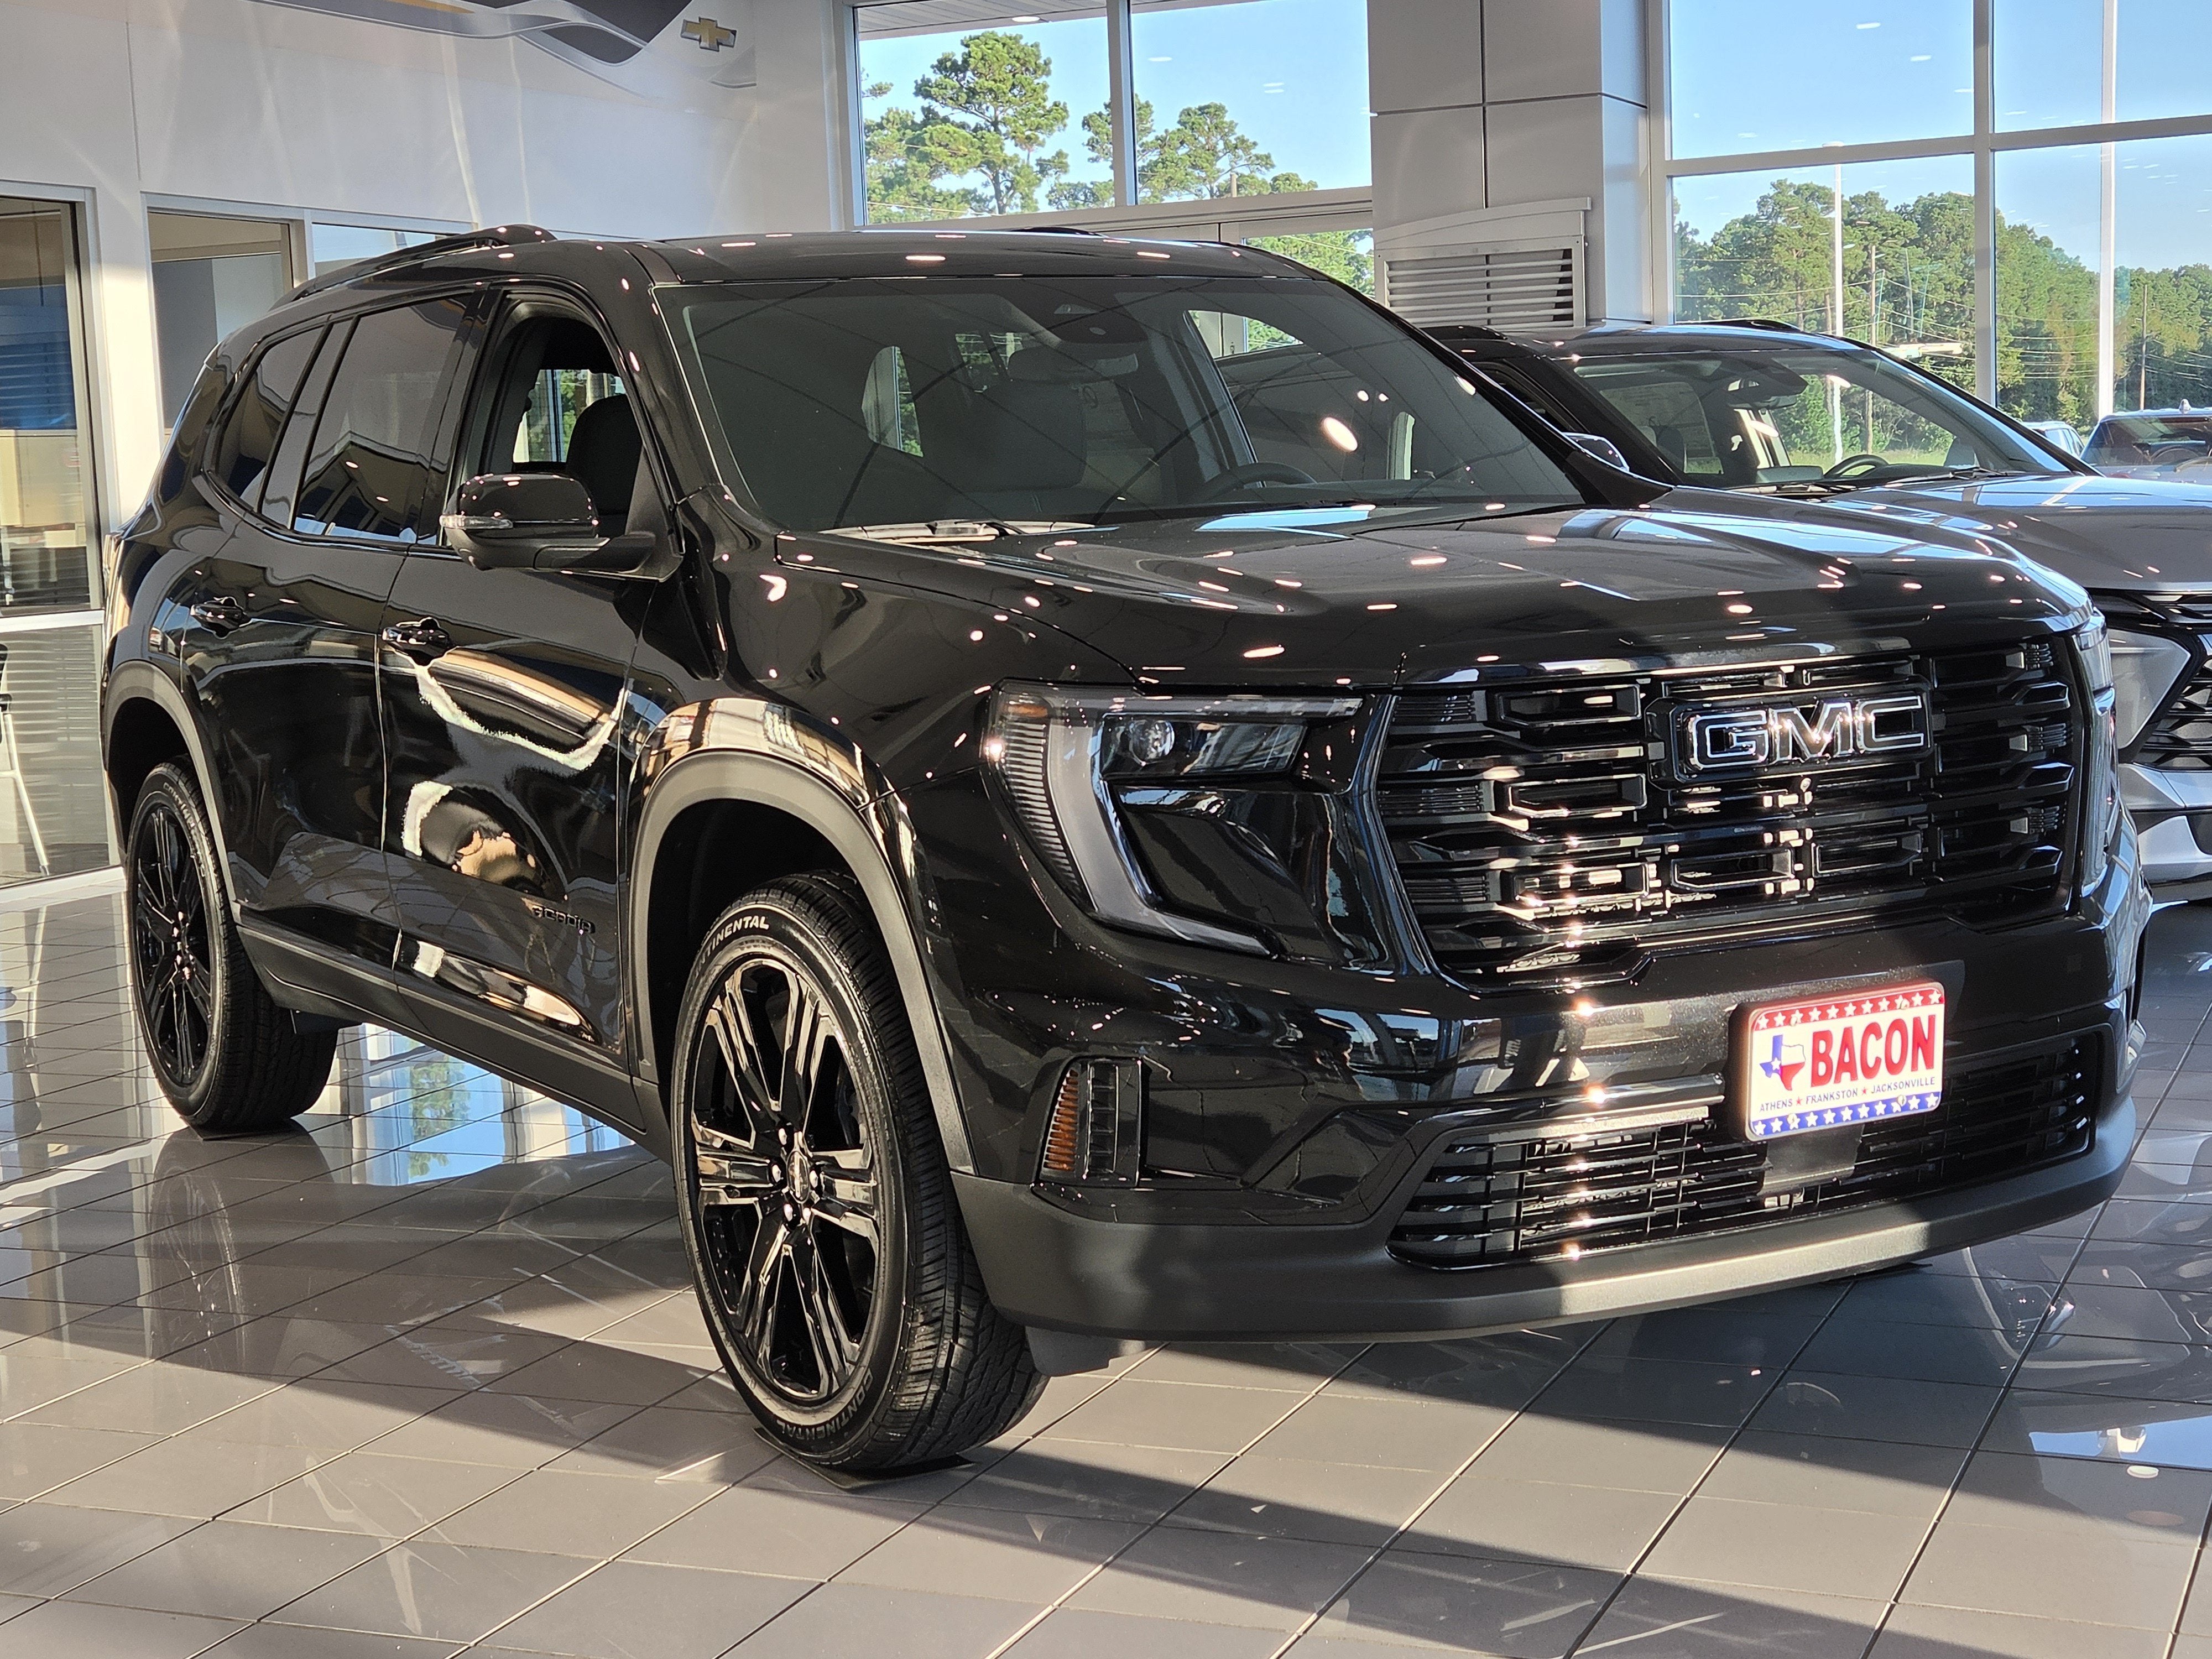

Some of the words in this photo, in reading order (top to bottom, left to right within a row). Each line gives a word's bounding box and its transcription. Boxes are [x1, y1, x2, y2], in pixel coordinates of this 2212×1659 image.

[1690, 695, 1925, 769] GMC
[1810, 1014, 1936, 1088] BACON
[1759, 1098, 1793, 1113] ATHENS
[1805, 1088, 1859, 1105] FRANKSTON
[1870, 1076, 1936, 1094] JACKSONVILLE
